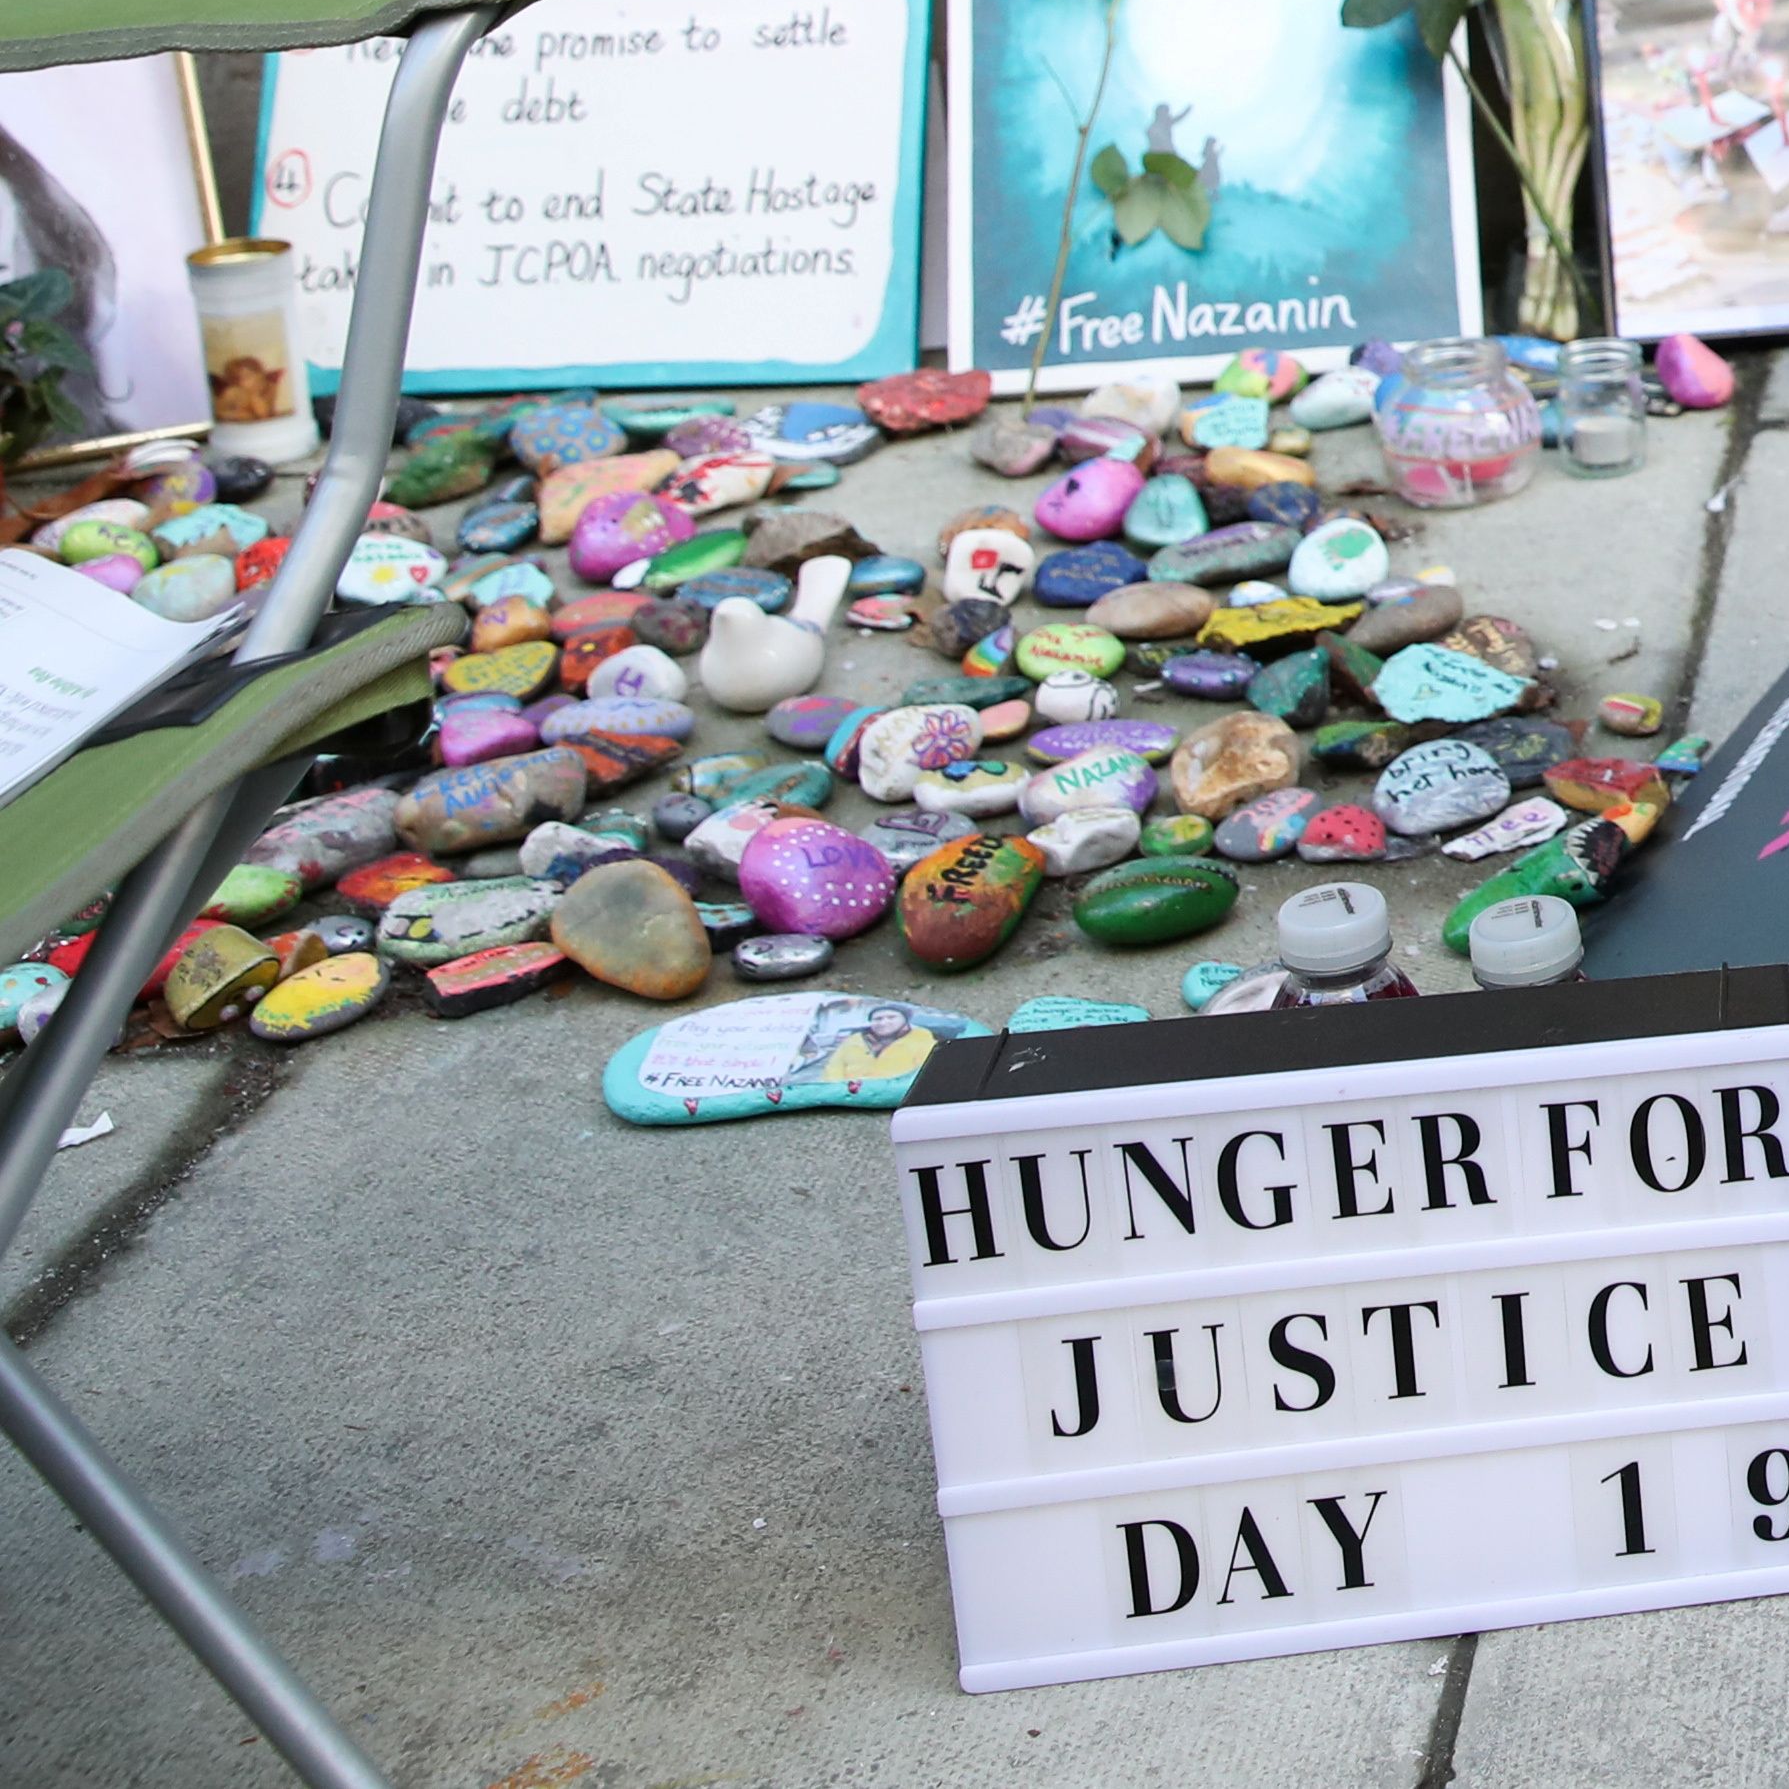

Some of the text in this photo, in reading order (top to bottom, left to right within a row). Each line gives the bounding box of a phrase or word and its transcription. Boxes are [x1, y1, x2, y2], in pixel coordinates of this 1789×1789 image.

[536, 28, 666, 74] promise
[685, 18, 721, 54] to
[753, 6, 848, 49] settle
[500, 75, 589, 124] debt
[480, 191, 523, 222] to
[543, 168, 604, 220] end
[632, 170, 736, 219] State
[745, 168, 878, 229] Hostage
[1389, 742, 1471, 780] bring
[908, 1110, 1498, 1269] HUNGER
[1049, 1272, 1749, 1439] JUSTICE
[1116, 1489, 1388, 1620] DAY
